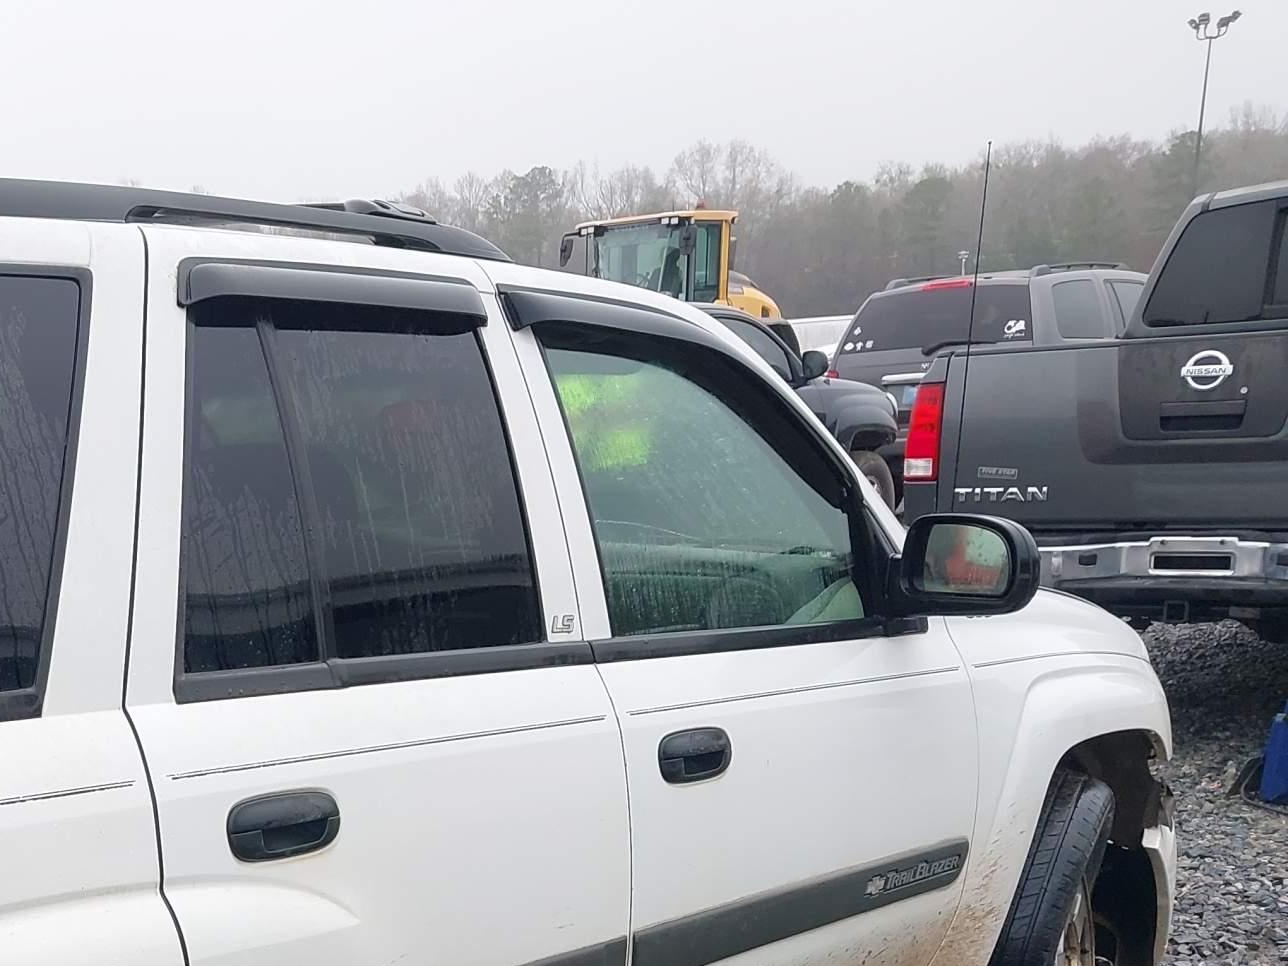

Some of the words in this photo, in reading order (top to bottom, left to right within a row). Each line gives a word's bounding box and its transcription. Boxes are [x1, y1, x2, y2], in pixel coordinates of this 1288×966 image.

[1185, 367, 1227, 376] NISSAN
[953, 486, 1048, 502] TITAN
[551, 614, 575, 634] LS
